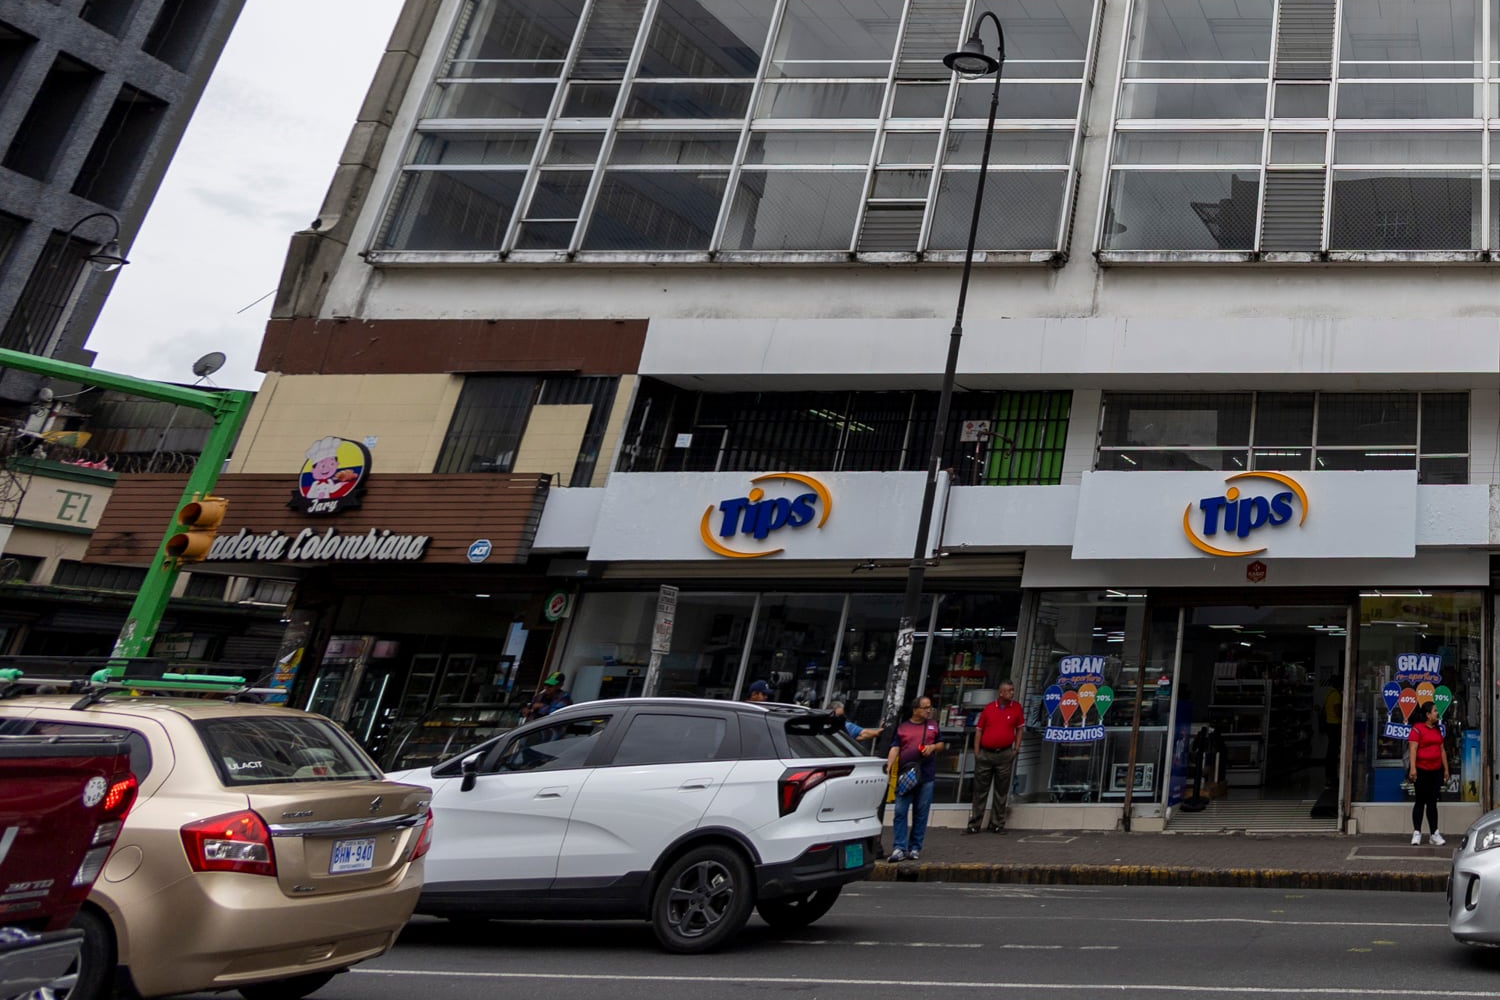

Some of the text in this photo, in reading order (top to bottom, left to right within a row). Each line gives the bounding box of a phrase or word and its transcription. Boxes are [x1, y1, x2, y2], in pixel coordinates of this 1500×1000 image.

[718, 487, 818, 540] Tips
[1199, 486, 1293, 538] Tips
[207, 527, 430, 561] aderia Colombiana
[1061, 657, 1103, 674] GRAN
[1398, 655, 1440, 672] GRAN
[1045, 726, 1104, 740] DESCUENTOS
[229, 761, 263, 770] ULACIT
